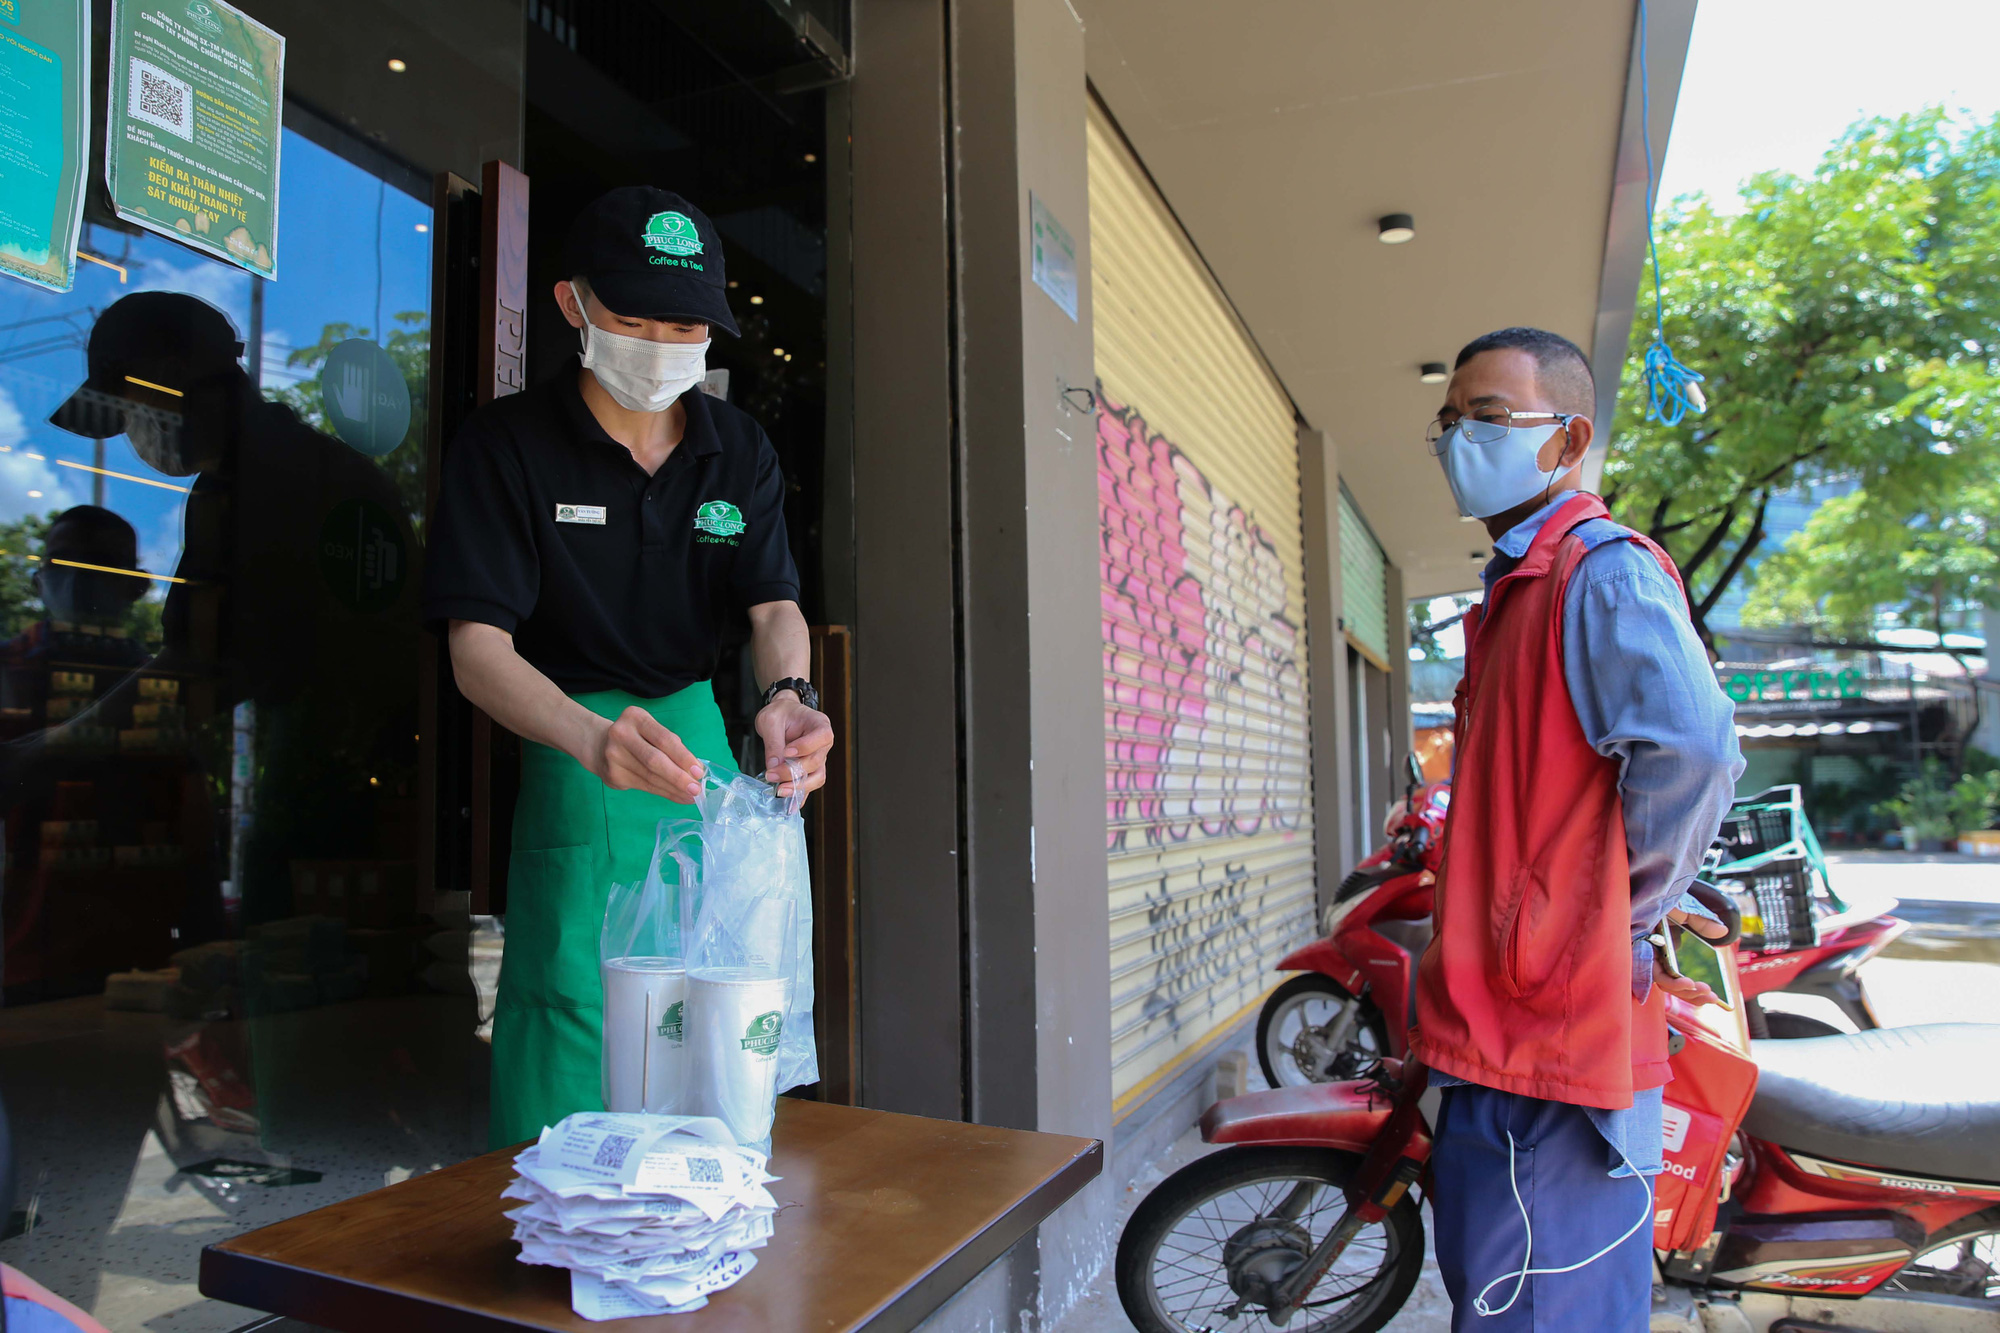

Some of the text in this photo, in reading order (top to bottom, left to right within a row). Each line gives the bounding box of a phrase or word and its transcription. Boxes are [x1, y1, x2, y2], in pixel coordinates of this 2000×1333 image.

[141, 12, 165, 29] CHUNG
[165, 25, 176, 36] TAY
[200, 46, 222, 62] CHỐNG
[157, 11, 173, 26] CÔNG
[174, 22, 181, 31] TY
[183, 27, 198, 41] TNHH
[221, 47, 238, 61] PHÚC
[239, 57, 253, 70] LONG
[127, 125, 155, 140] ĐỀ NGHỊ:
[126, 133, 149, 145] KHÁCH
[150, 139, 166, 153] HÀNG
[185, 157, 194, 166] KHI
[195, 160, 206, 171] VÀO
[218, 170, 233, 184] HÀNG
[149, 156, 243, 207] KIỂM RA THÂN NHIỆT
[147, 185, 166, 201] SÁT
[203, 207, 220, 224] TAY
[148, 171, 247, 223] ĐEO KHẨU TRANG Y TẾ
[647, 236, 675, 245] PHUC
[676, 238, 701, 251] LONG
[649, 255, 704, 272] Coffee & Tea
[720, 521, 743, 531] LONG
[696, 535, 720, 544] Coffee
[1725, 668, 1862, 703] OFFEE
[745, 1034, 780, 1048] PHUC LO
[1662, 1159, 1697, 1181] ood
[1880, 1178, 1957, 1194] HONDA
